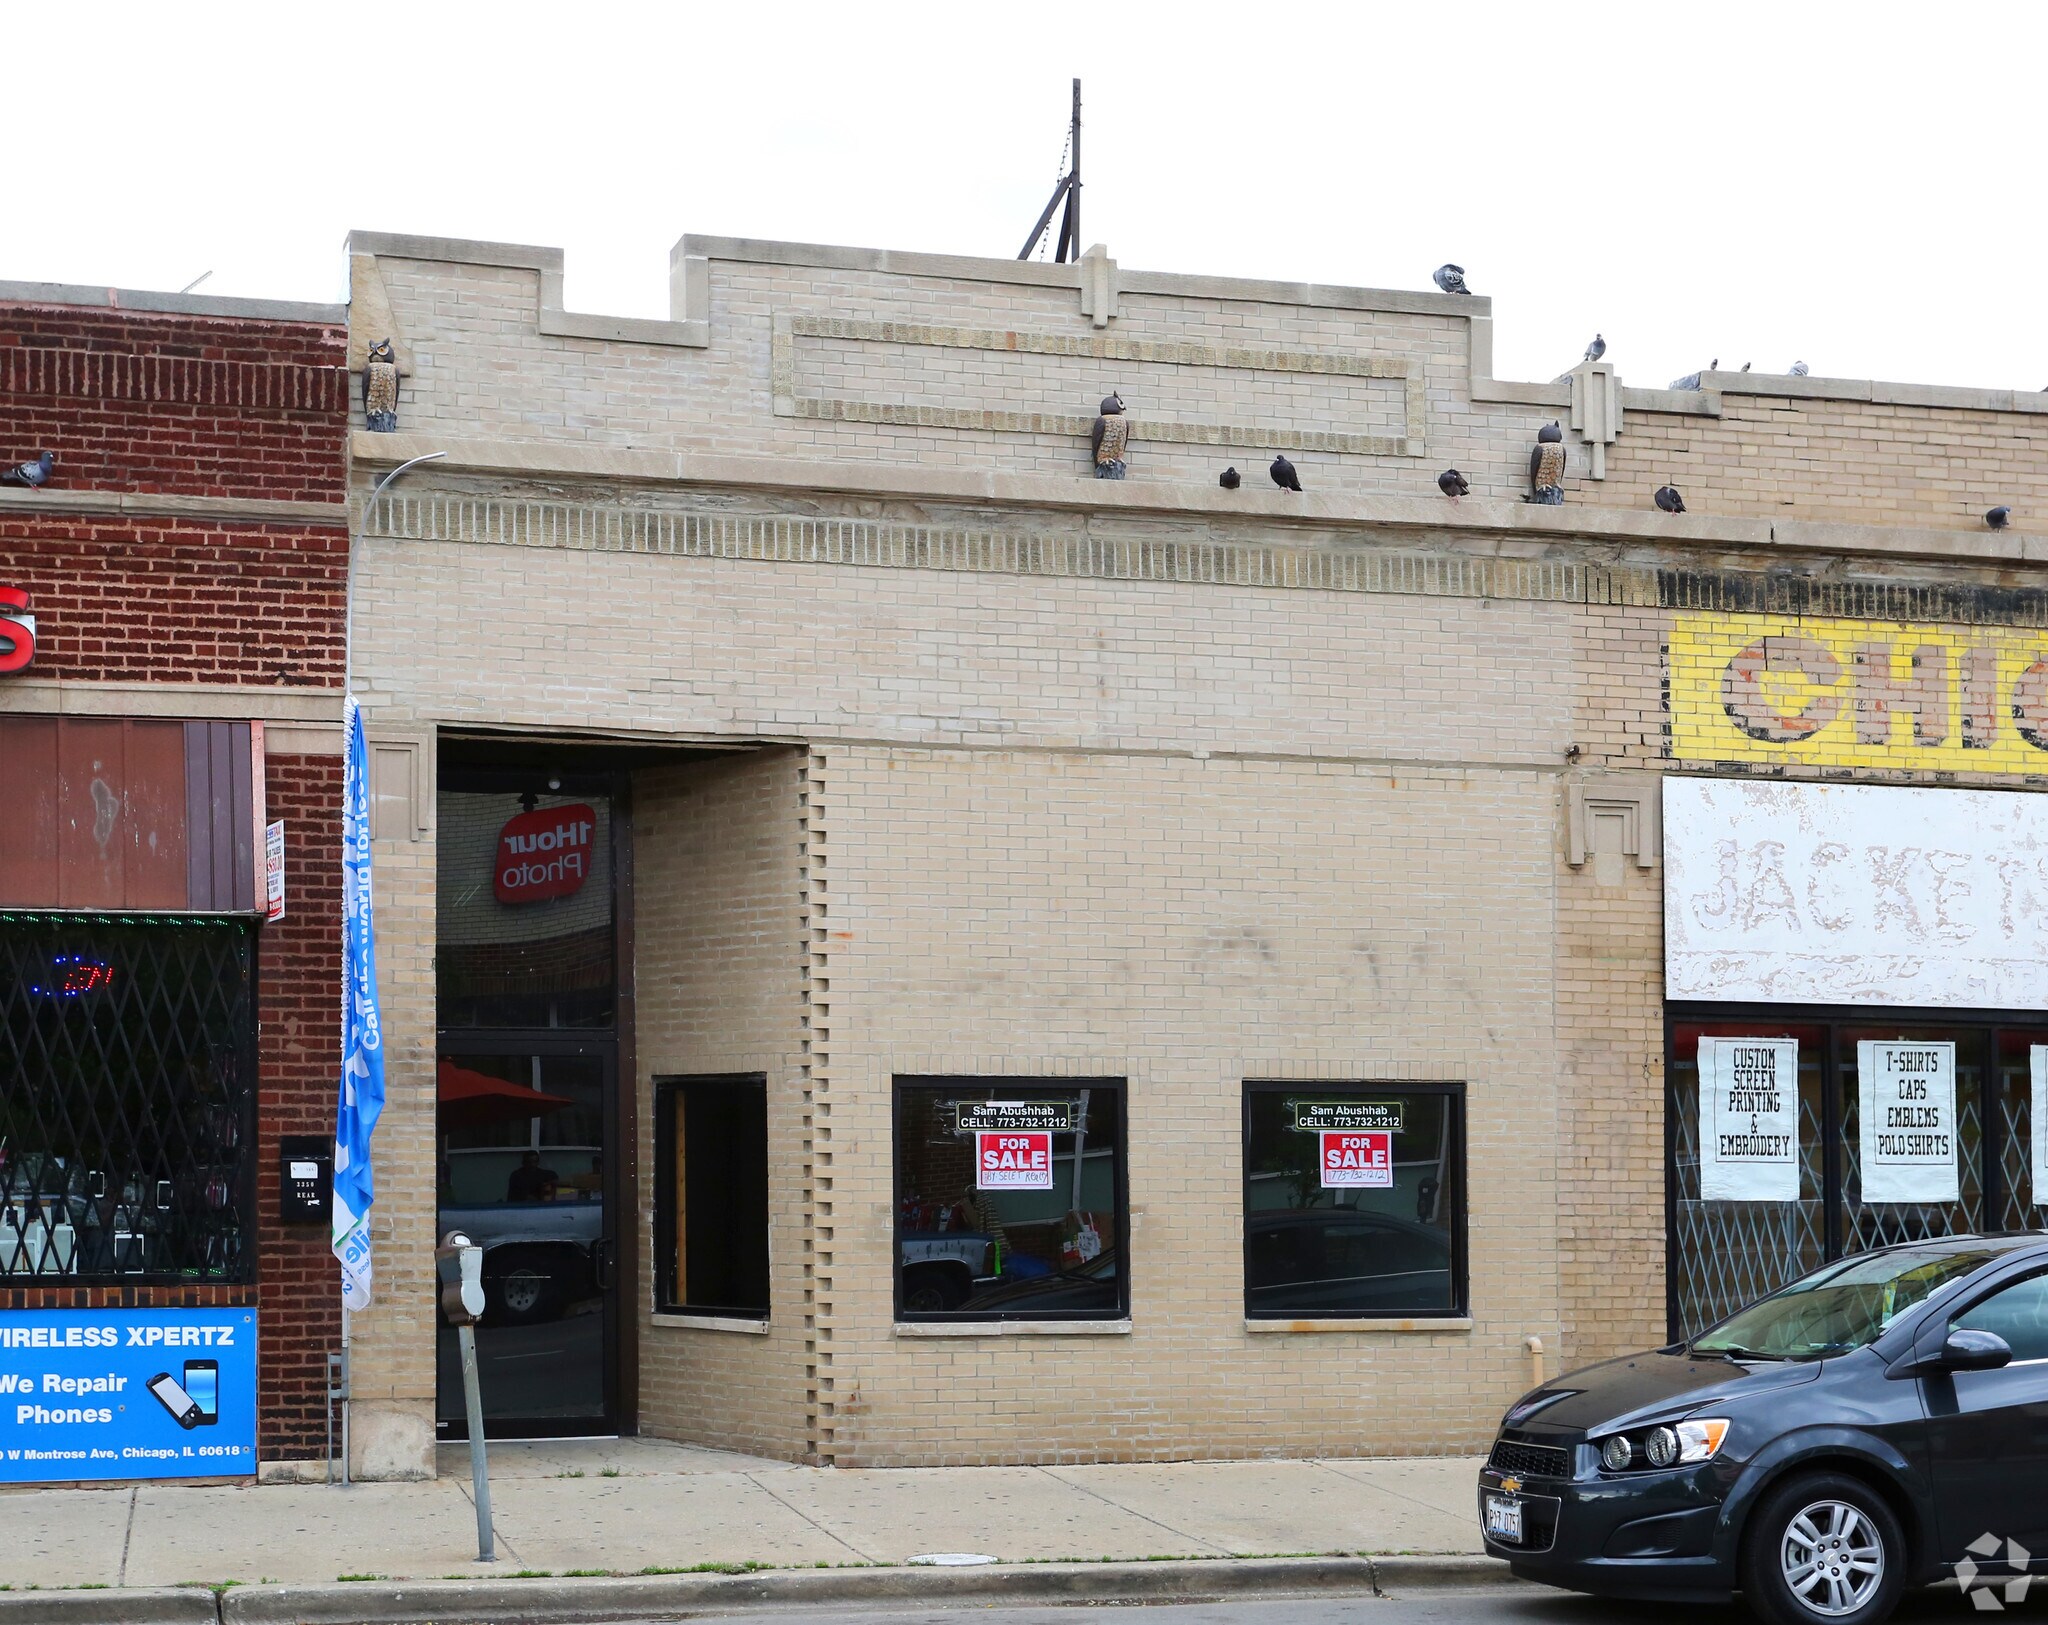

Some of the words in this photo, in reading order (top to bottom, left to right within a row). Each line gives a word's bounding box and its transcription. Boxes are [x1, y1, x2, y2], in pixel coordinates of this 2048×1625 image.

[361, 999, 380, 1051] Call
[1733, 1048, 1776, 1069] CUSTOM
[1886, 1051, 1938, 1072] T-SHIRTS
[1733, 1070, 1775, 1090] SCREEN
[1898, 1079, 1926, 1100] CAPS
[973, 1106, 997, 1116] Sam
[999, 1105, 1055, 1116] Abushhab
[1310, 1105, 1333, 1115] Sam
[1336, 1105, 1388, 1115] Abushhab
[1729, 1091, 1780, 1112] PRINTING
[961, 1118, 994, 1127] CELL:
[997, 1117, 1067, 1127] 773-732-1212
[1299, 1117, 1331, 1126] CELL:
[1333, 1117, 1400, 1126] 773-732-1212
[1751, 1113, 1758, 1134] &
[1887, 1107, 1939, 1127] EMBLEMS
[999, 1138, 1030, 1149] FOR
[1341, 1137, 1371, 1149] FOR
[1719, 1135, 1790, 1156] EMBROIDERY
[1878, 1135, 1905, 1155] POLO
[1908, 1135, 1949, 1155] SHIRTS
[983, 1150, 1046, 1169] SALE
[1327, 1149, 1387, 1168] SALE
[1331, 1170, 1386, 1181] 773-732-1212
[0, 1326, 118, 1348] IRELESS
[126, 1326, 234, 1346] XPERTZ
[0, 1374, 33, 1394] We
[43, 1373, 128, 1396] Repair
[17, 1405, 112, 1424] Phones
[8, 1450, 21, 1460] W
[24, 1449, 86, 1460] Montrose
[90, 1448, 118, 1461] Ave,
[122, 1446, 179, 1459] Chicago,
[183, 1446, 195, 1457] IL
[198, 1446, 240, 1456] 60618
